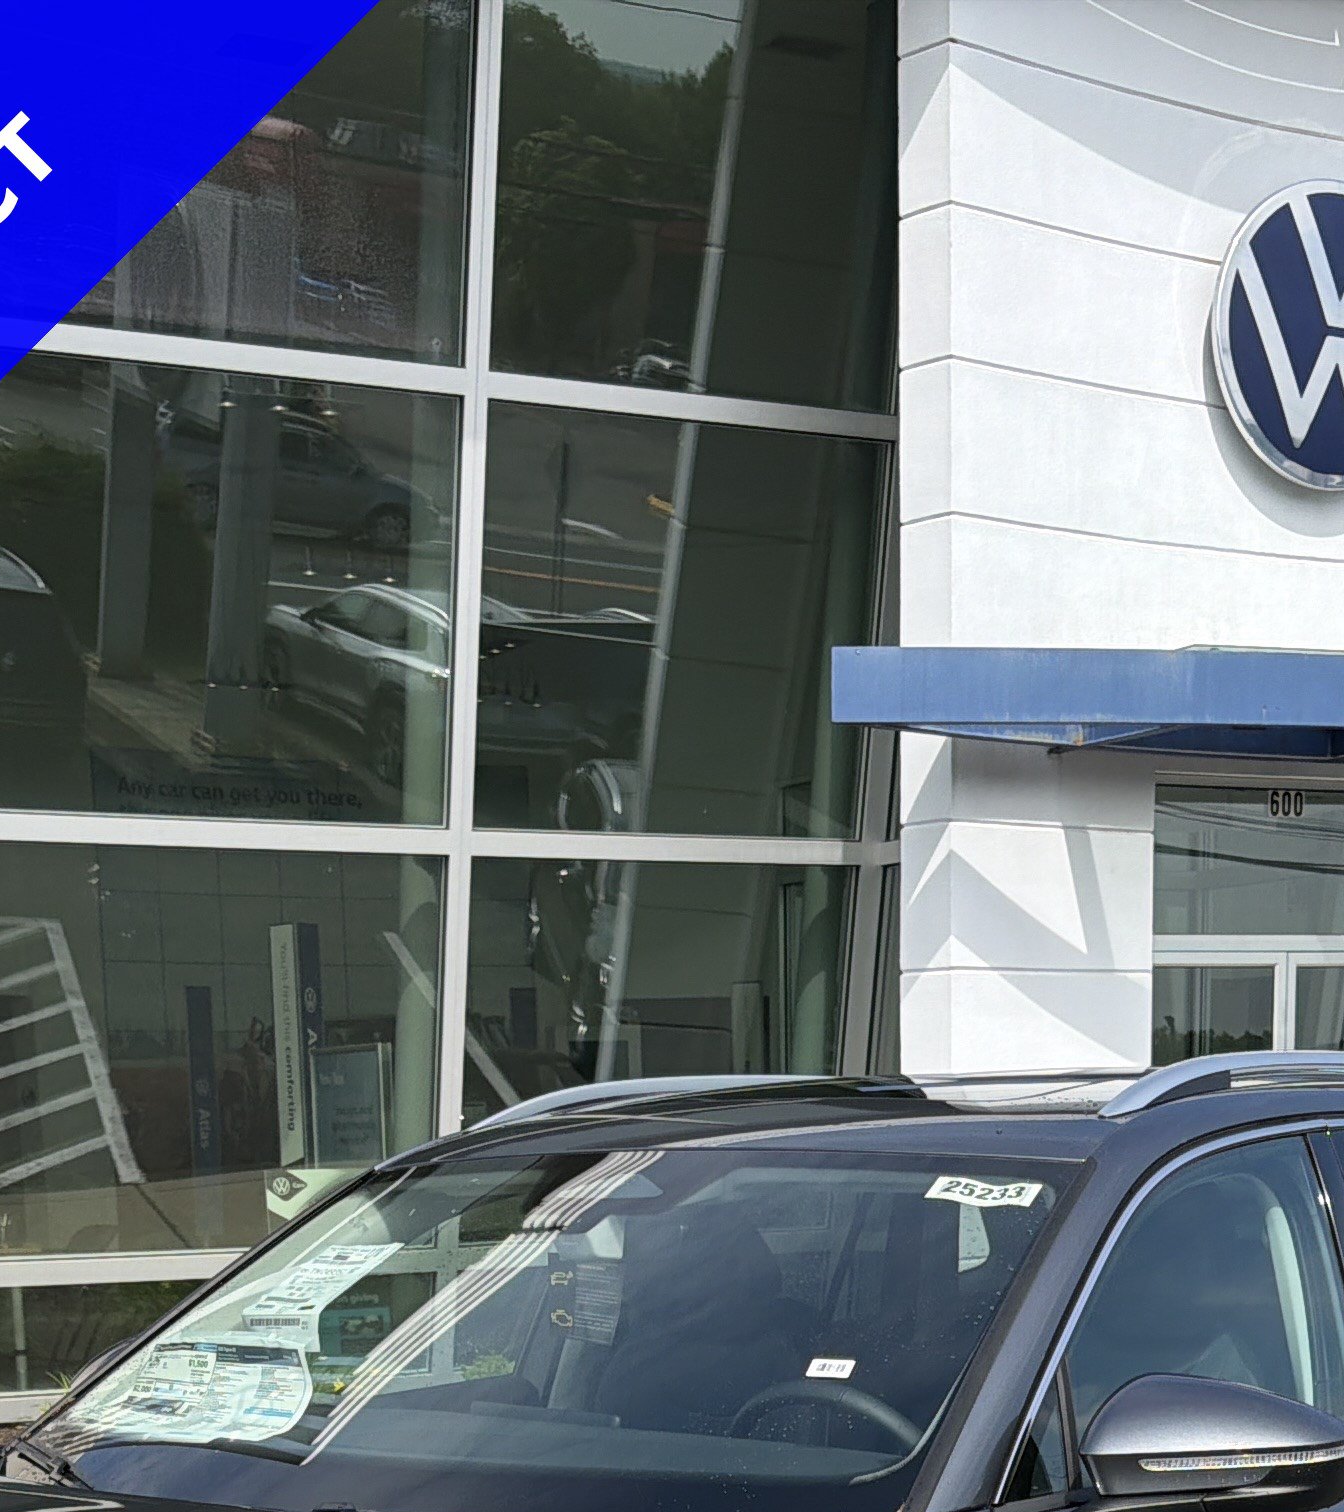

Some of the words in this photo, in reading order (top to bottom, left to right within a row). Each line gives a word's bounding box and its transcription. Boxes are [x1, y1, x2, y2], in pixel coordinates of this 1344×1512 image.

[157, 783, 187, 798] car
[192, 784, 224, 799] can
[229, 785, 261, 806] get
[266, 788, 300, 807] you
[1270, 790, 1304, 817] 600
[285, 1046, 297, 1132] comforting
[940, 1180, 1026, 1201] 25233
